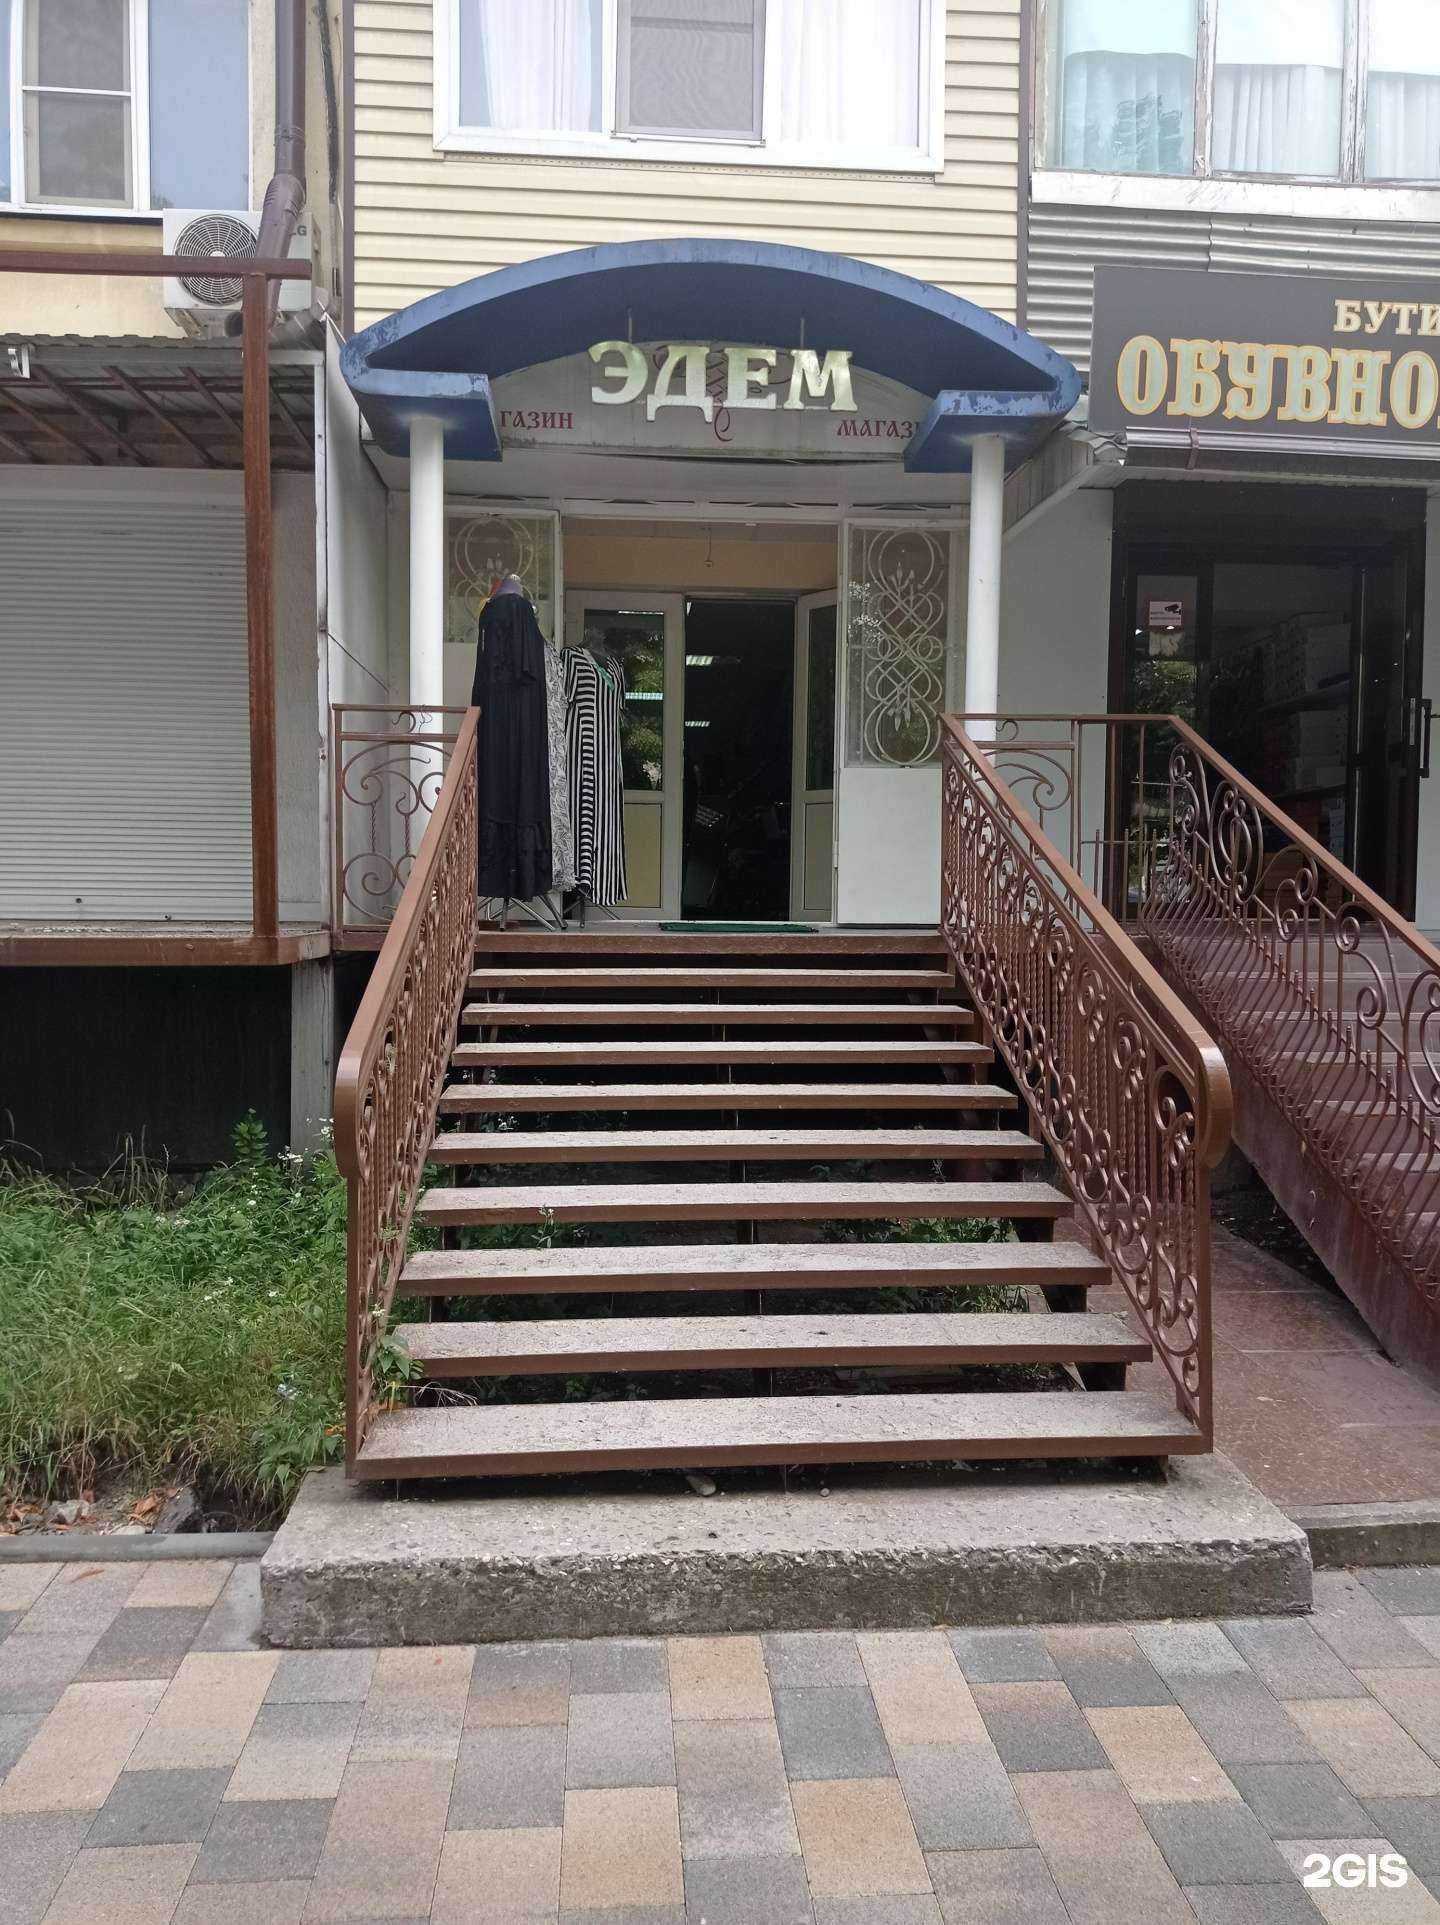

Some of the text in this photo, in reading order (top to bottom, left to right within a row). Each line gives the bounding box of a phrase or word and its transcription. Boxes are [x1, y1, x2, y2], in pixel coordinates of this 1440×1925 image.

[1333, 299, 1440, 336] БУТИ
[588, 340, 858, 423] ЭДЕМ
[1117, 334, 1440, 429] ОБУВНО
[500, 410, 574, 430] ГАЗИН
